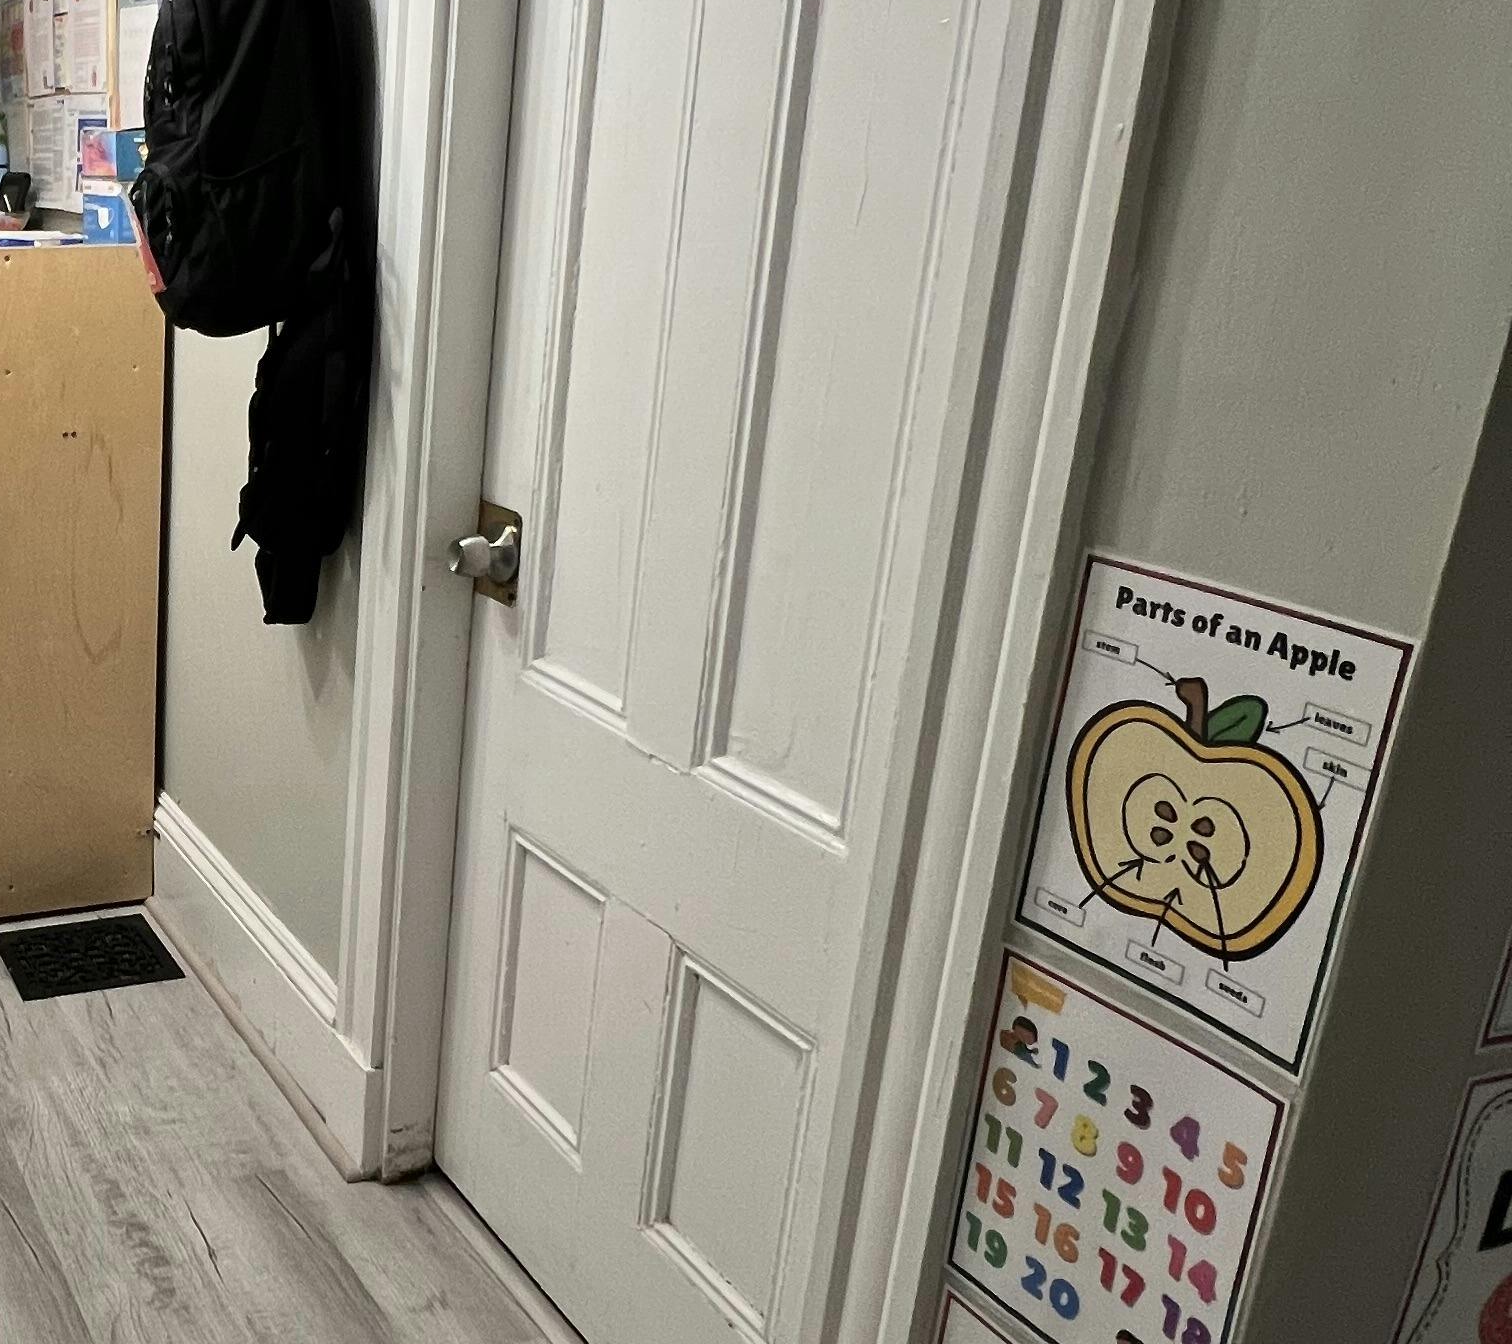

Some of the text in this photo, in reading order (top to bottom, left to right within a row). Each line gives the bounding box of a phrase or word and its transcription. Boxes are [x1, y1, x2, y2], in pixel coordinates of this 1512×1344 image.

[1115, 585, 1356, 681] Parts of an Apple
[984, 1113, 1024, 1169] 11
[1038, 1147, 1086, 1210] 12
[1101, 1187, 1150, 1253] 13
[992, 1067, 1217, 1236] 6 7 8 9 10
[1051, 1037, 1071, 1083] 1
[1083, 1059, 1111, 1107] 2
[1124, 1084, 1154, 1131] 3
[1217, 1140, 1248, 1190] 5
[965, 1210, 1081, 1322] 19 20
[975, 1162, 1017, 1219] 15
[1032, 1202, 1081, 1264] 16
[1095, 1246, 1147, 1309] 17
